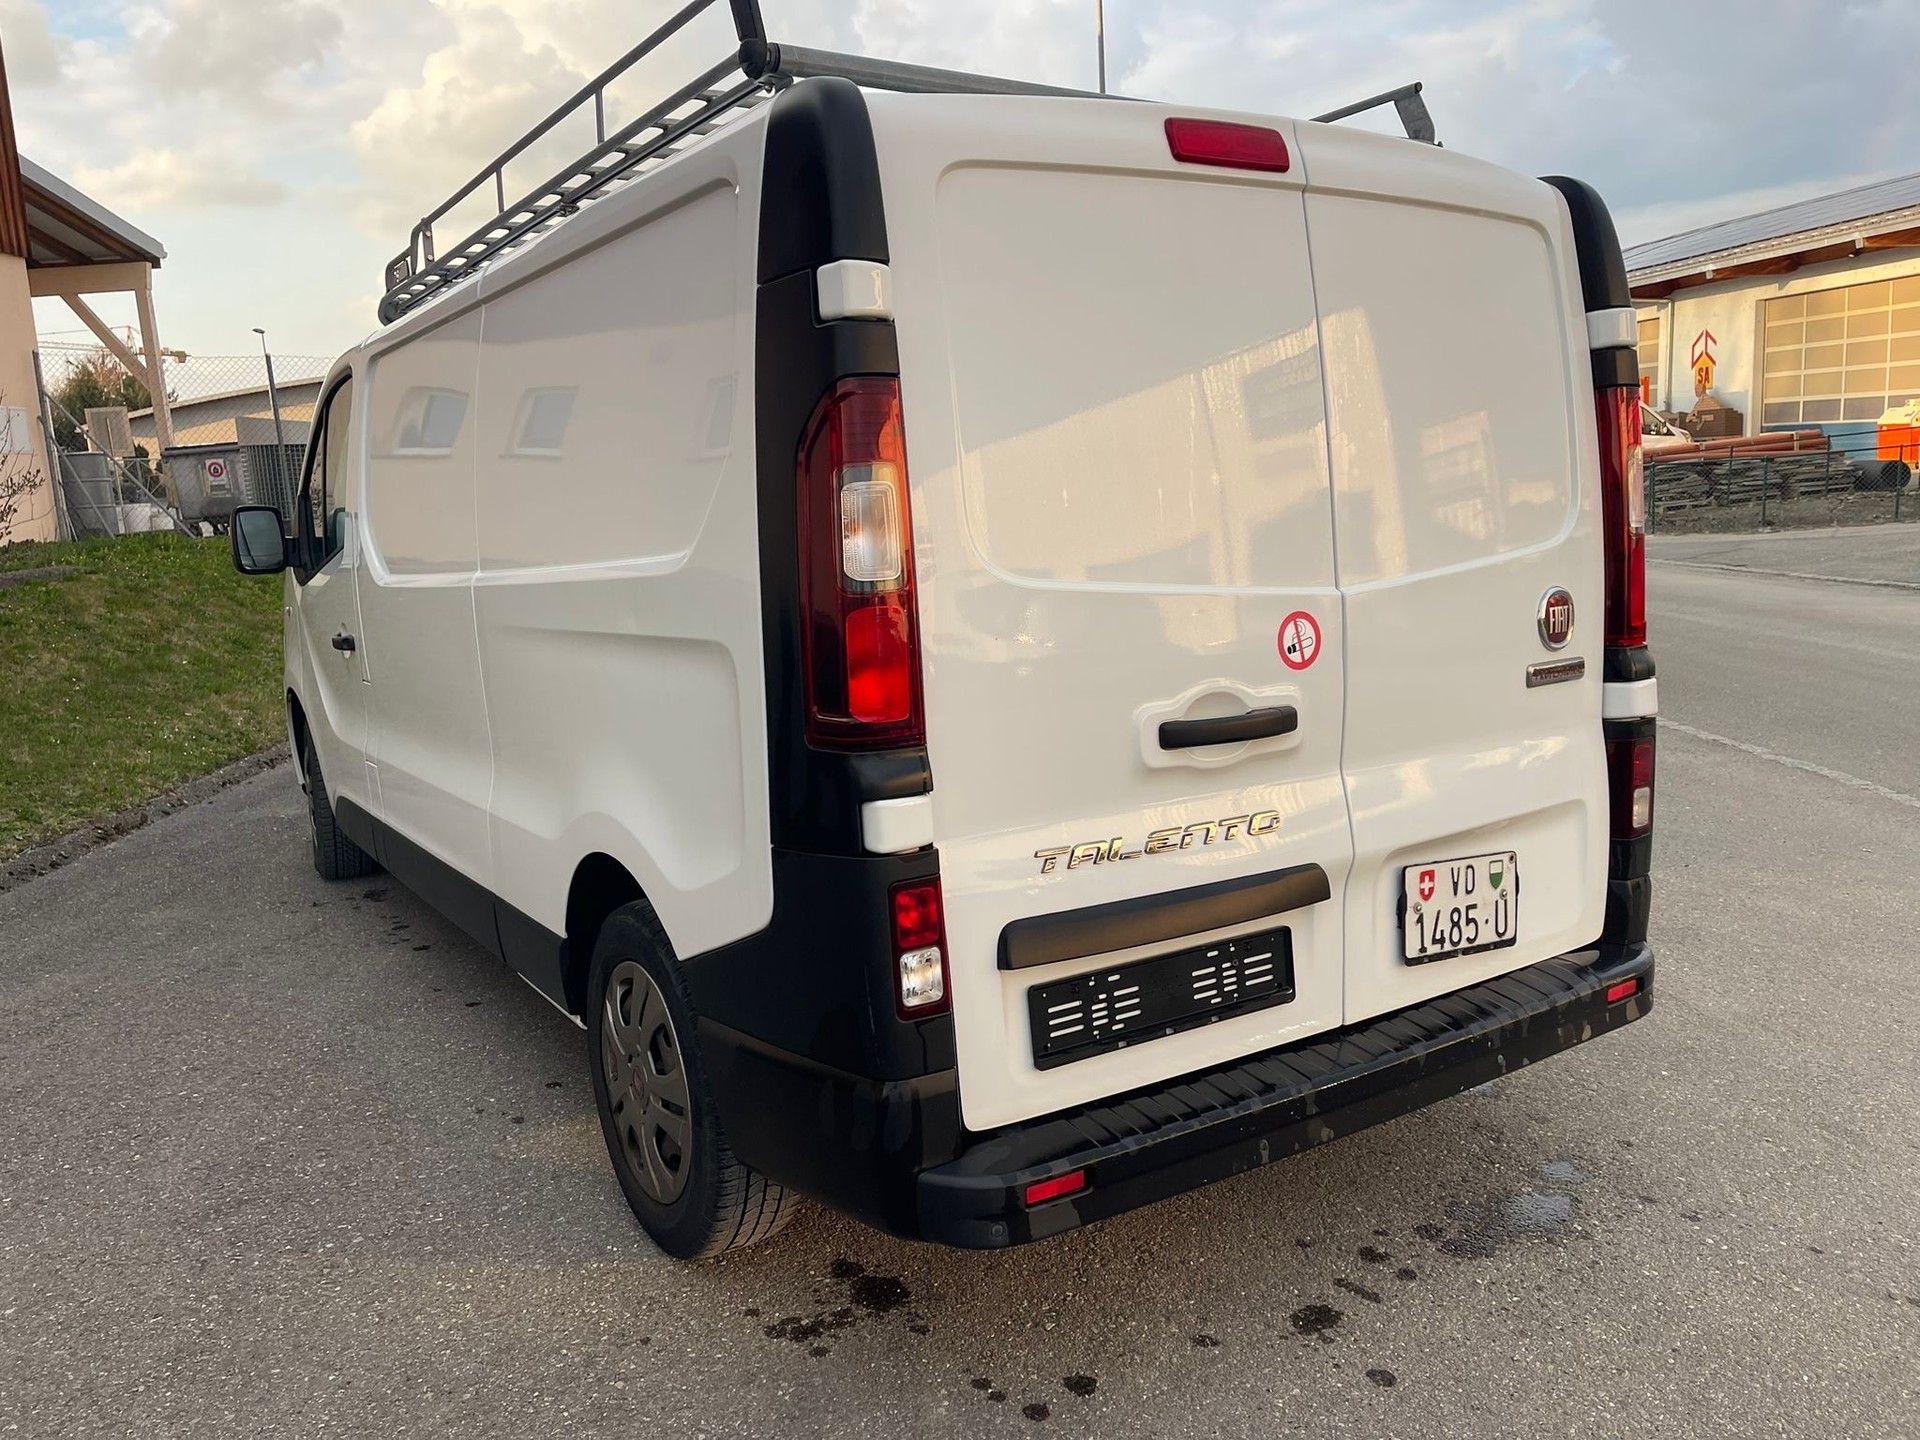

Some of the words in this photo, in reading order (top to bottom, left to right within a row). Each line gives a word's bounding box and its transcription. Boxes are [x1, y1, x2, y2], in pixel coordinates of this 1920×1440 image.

[1698, 366, 1710, 384] SA
[1549, 605, 1569, 634] FIAT
[1034, 810, 1281, 874] TALENTO
[1451, 864, 1475, 897] VD
